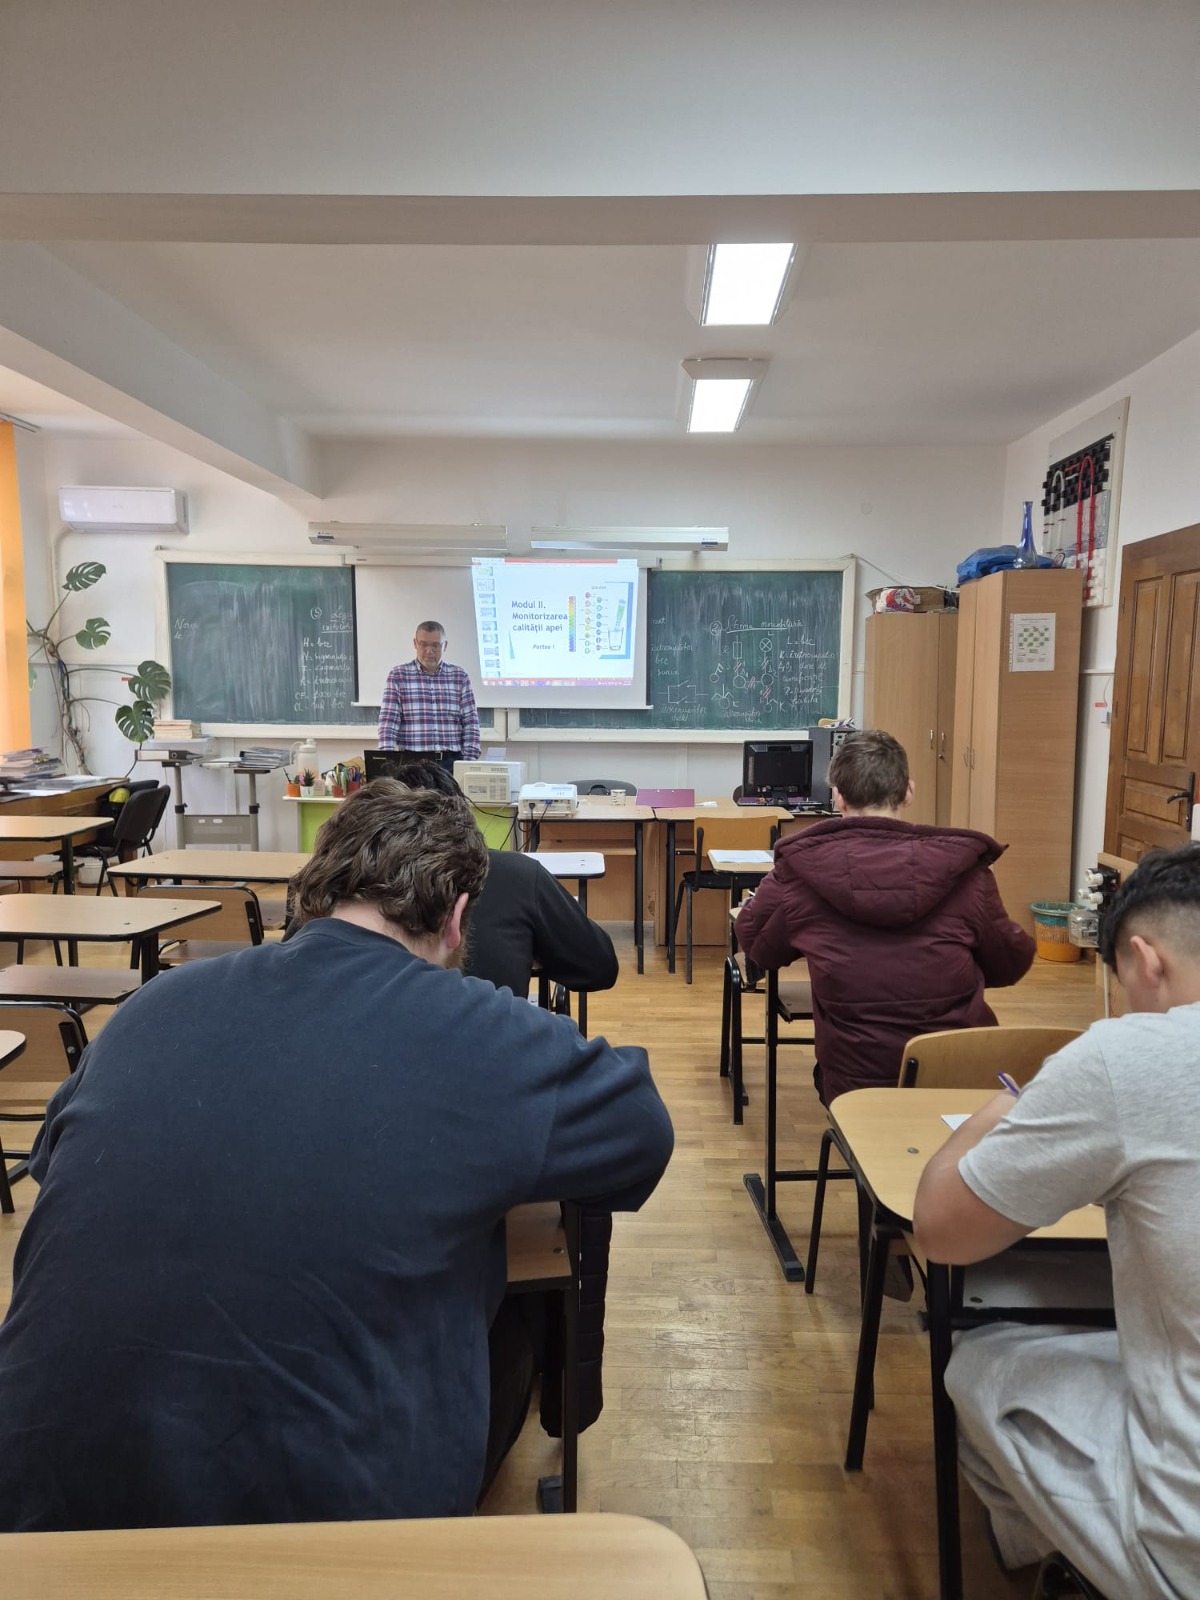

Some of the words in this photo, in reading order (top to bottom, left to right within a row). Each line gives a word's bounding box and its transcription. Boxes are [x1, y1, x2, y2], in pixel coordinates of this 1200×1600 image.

[511, 600, 536, 609] Modul
[511, 612, 569, 620] Monitorizarea
[545, 624, 563, 633] apei
